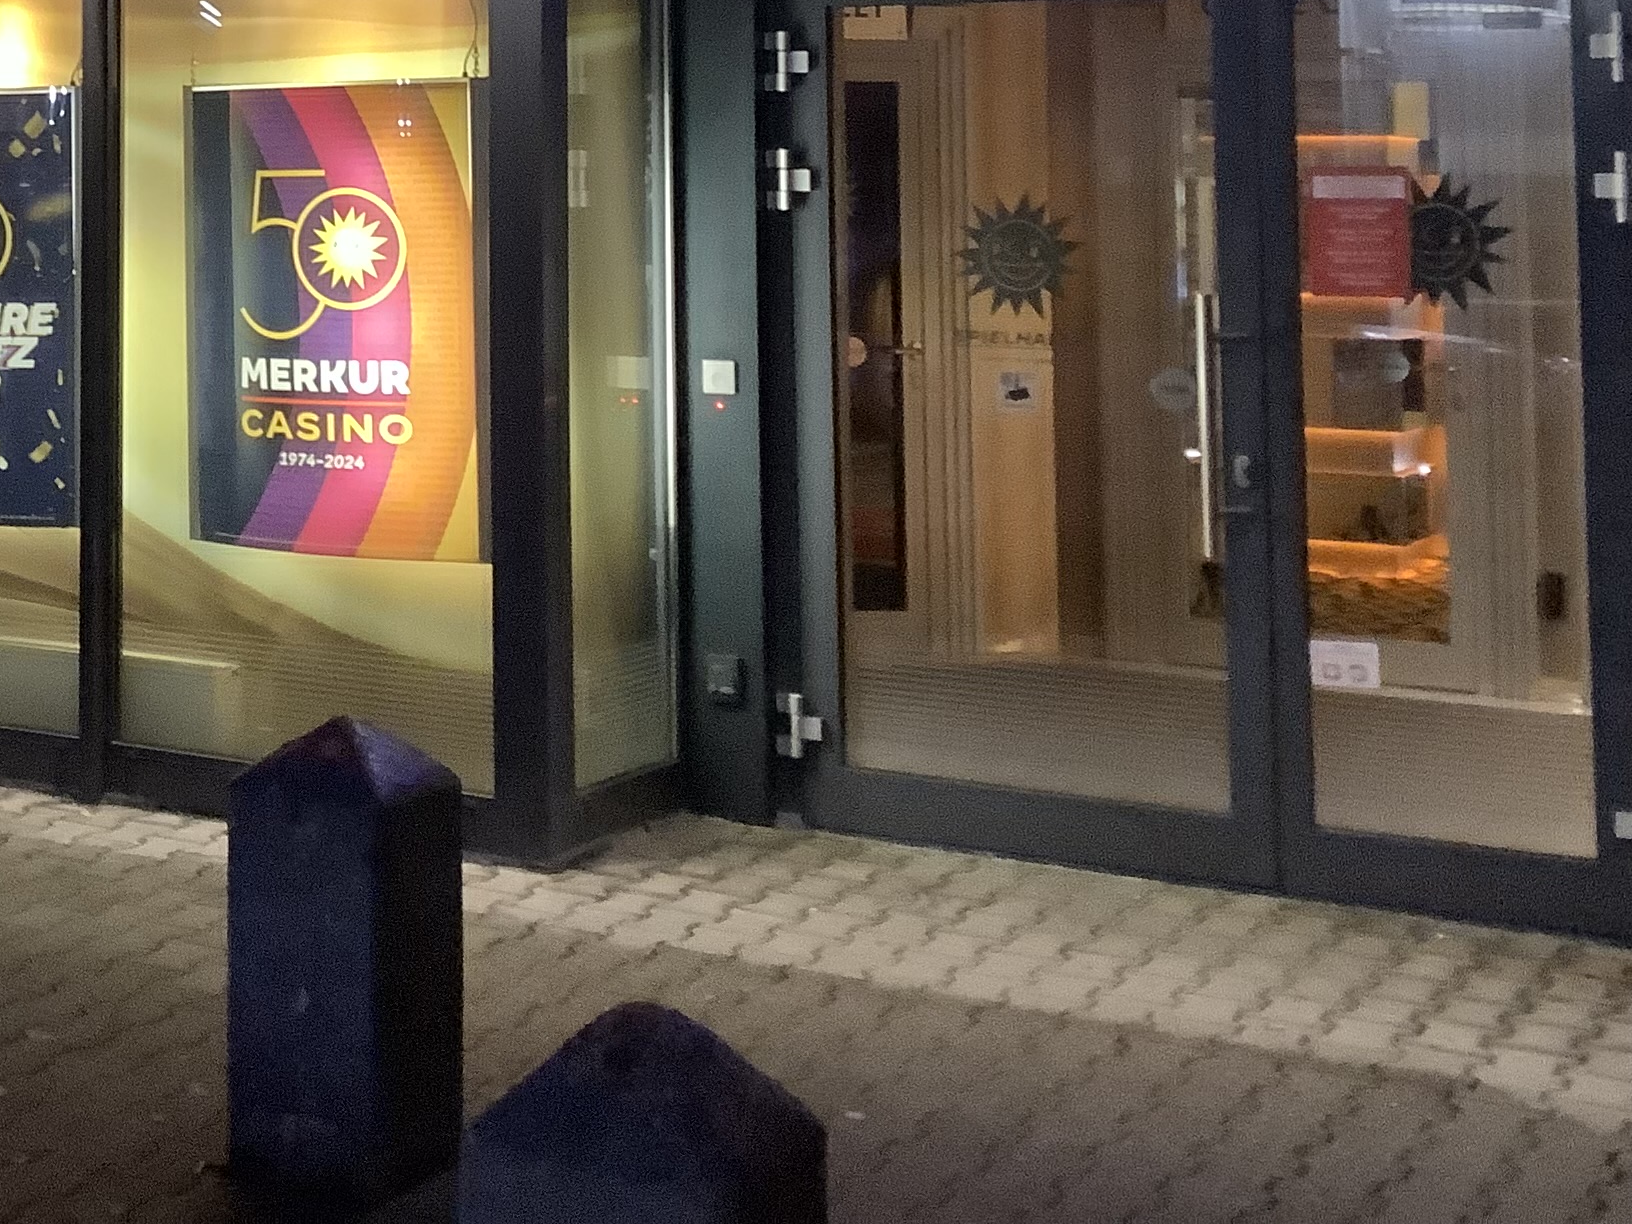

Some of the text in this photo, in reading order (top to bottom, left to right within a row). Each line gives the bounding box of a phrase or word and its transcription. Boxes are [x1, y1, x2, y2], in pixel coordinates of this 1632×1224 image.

[240, 169, 408, 341] 50
[241, 356, 412, 396] MERKUR
[240, 408, 414, 446] CASINO
[278, 450, 366, 471] 1974-2024
